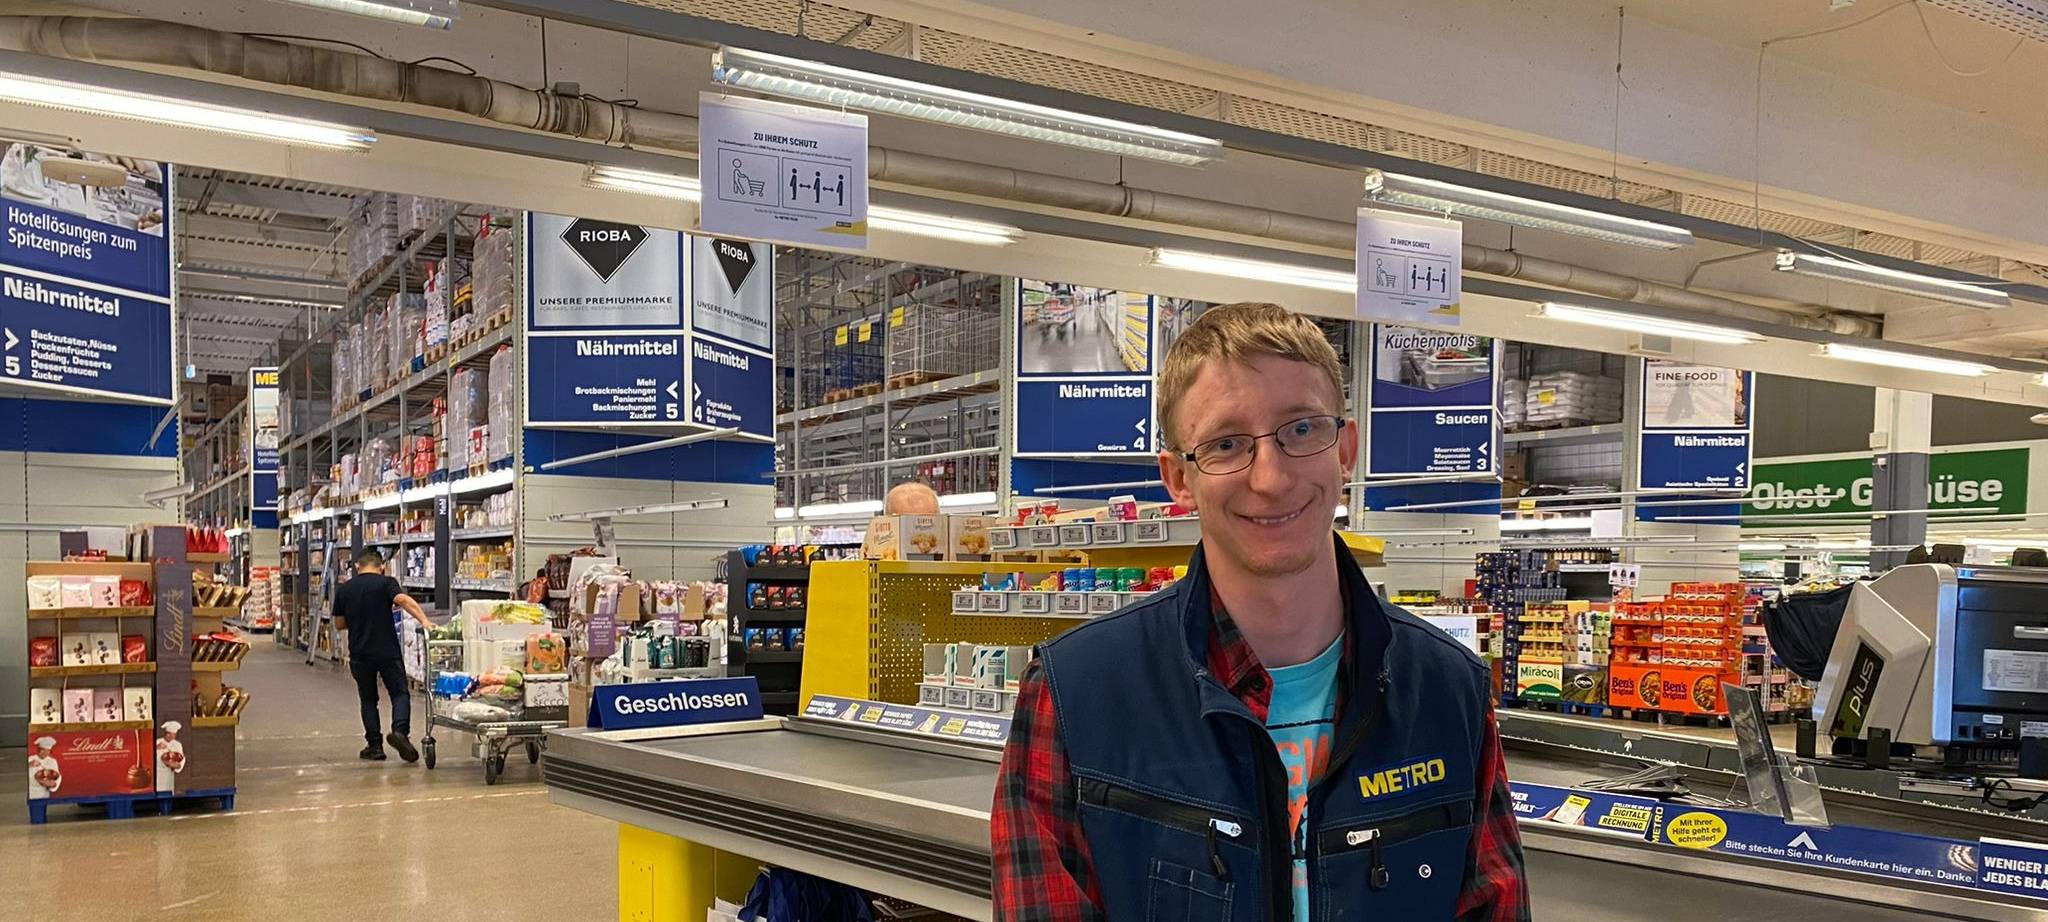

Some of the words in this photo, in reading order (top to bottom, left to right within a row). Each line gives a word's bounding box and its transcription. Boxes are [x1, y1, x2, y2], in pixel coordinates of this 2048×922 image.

[753, 132, 763, 142] ZU
[764, 134, 788, 145] IHREM
[789, 138, 818, 149] SCHUTZ
[8, 207, 107, 244] Hotellösungen
[110, 234, 137, 251] zum
[580, 230, 631, 242] RIOBA
[8, 227, 92, 260] Spitzenpreis
[720, 243, 749, 264] RIOBA
[4, 277, 120, 317] Nährmittel
[539, 297, 582, 305] UNSERE
[585, 296, 673, 305] PREMIUMMARKE
[696, 300, 721, 314] UNSERE
[723, 307, 768, 329] PREMIUMMARKE
[577, 340, 677, 356] Nährmittel
[1384, 332, 1476, 350] Küchenprofis
[31, 340, 99, 359] Trockenfrüchte
[31, 350, 69, 365] Pudding,
[72, 356, 112, 370] Desserts
[694, 343, 749, 371] Nährmittel
[5, 356, 20, 376] 5
[31, 370, 63, 382] Zucker
[636, 378, 656, 386] Mehl
[1656, 372, 1681, 380] FINE
[1685, 372, 1718, 380] FOOD
[575, 387, 656, 396] Brotbackmischungen
[1059, 384, 1146, 398] Nährmittel
[613, 395, 656, 403] Paniermehl
[593, 403, 656, 413] Backmischungen
[630, 411, 656, 419] Zucker
[666, 403, 678, 419] 5
[694, 405, 702, 421] 4
[1435, 413, 1488, 424] Saucen
[1133, 437, 1145, 450] 4
[1674, 436, 1745, 446] Nährmittel
[1477, 458, 1487, 470] 3
[1734, 476, 1744, 487] 2
[1750, 481, 1829, 509] Obst
[1851, 474, 2003, 506] Güse
[163, 601, 184, 656] Lindt
[1612, 677, 1635, 688] Ben's
[1663, 681, 1688, 692] Ben's
[614, 691, 749, 715] Geschlossen
[68, 737, 113, 751] Lindt
[1358, 758, 1446, 799] METRO
[1511, 791, 1528, 801] PIER
[1613, 808, 1647, 820] DIGITALE
[1602, 817, 1643, 830] RECHNUNG
[1652, 806, 1664, 843] METRO
[1672, 827, 1690, 835] Hilfe
[1692, 827, 1709, 835] geht
[1678, 835, 1716, 843] schneller!
[1725, 840, 1746, 850] Bitte
[1748, 843, 1785, 856] stecken
[1787, 848, 1802, 858] Sie
[1804, 850, 1823, 861] Ihre
[1825, 853, 1890, 871] Kundenkarte
[1892, 862, 1913, 875] hier
[1915, 867, 1934, 878] ein.
[1937, 869, 1975, 884] Danke.
[1984, 856, 2042, 874] WENIGER
[1983, 872, 2022, 887] JEDES
[2024, 876, 2048, 891] BLA
